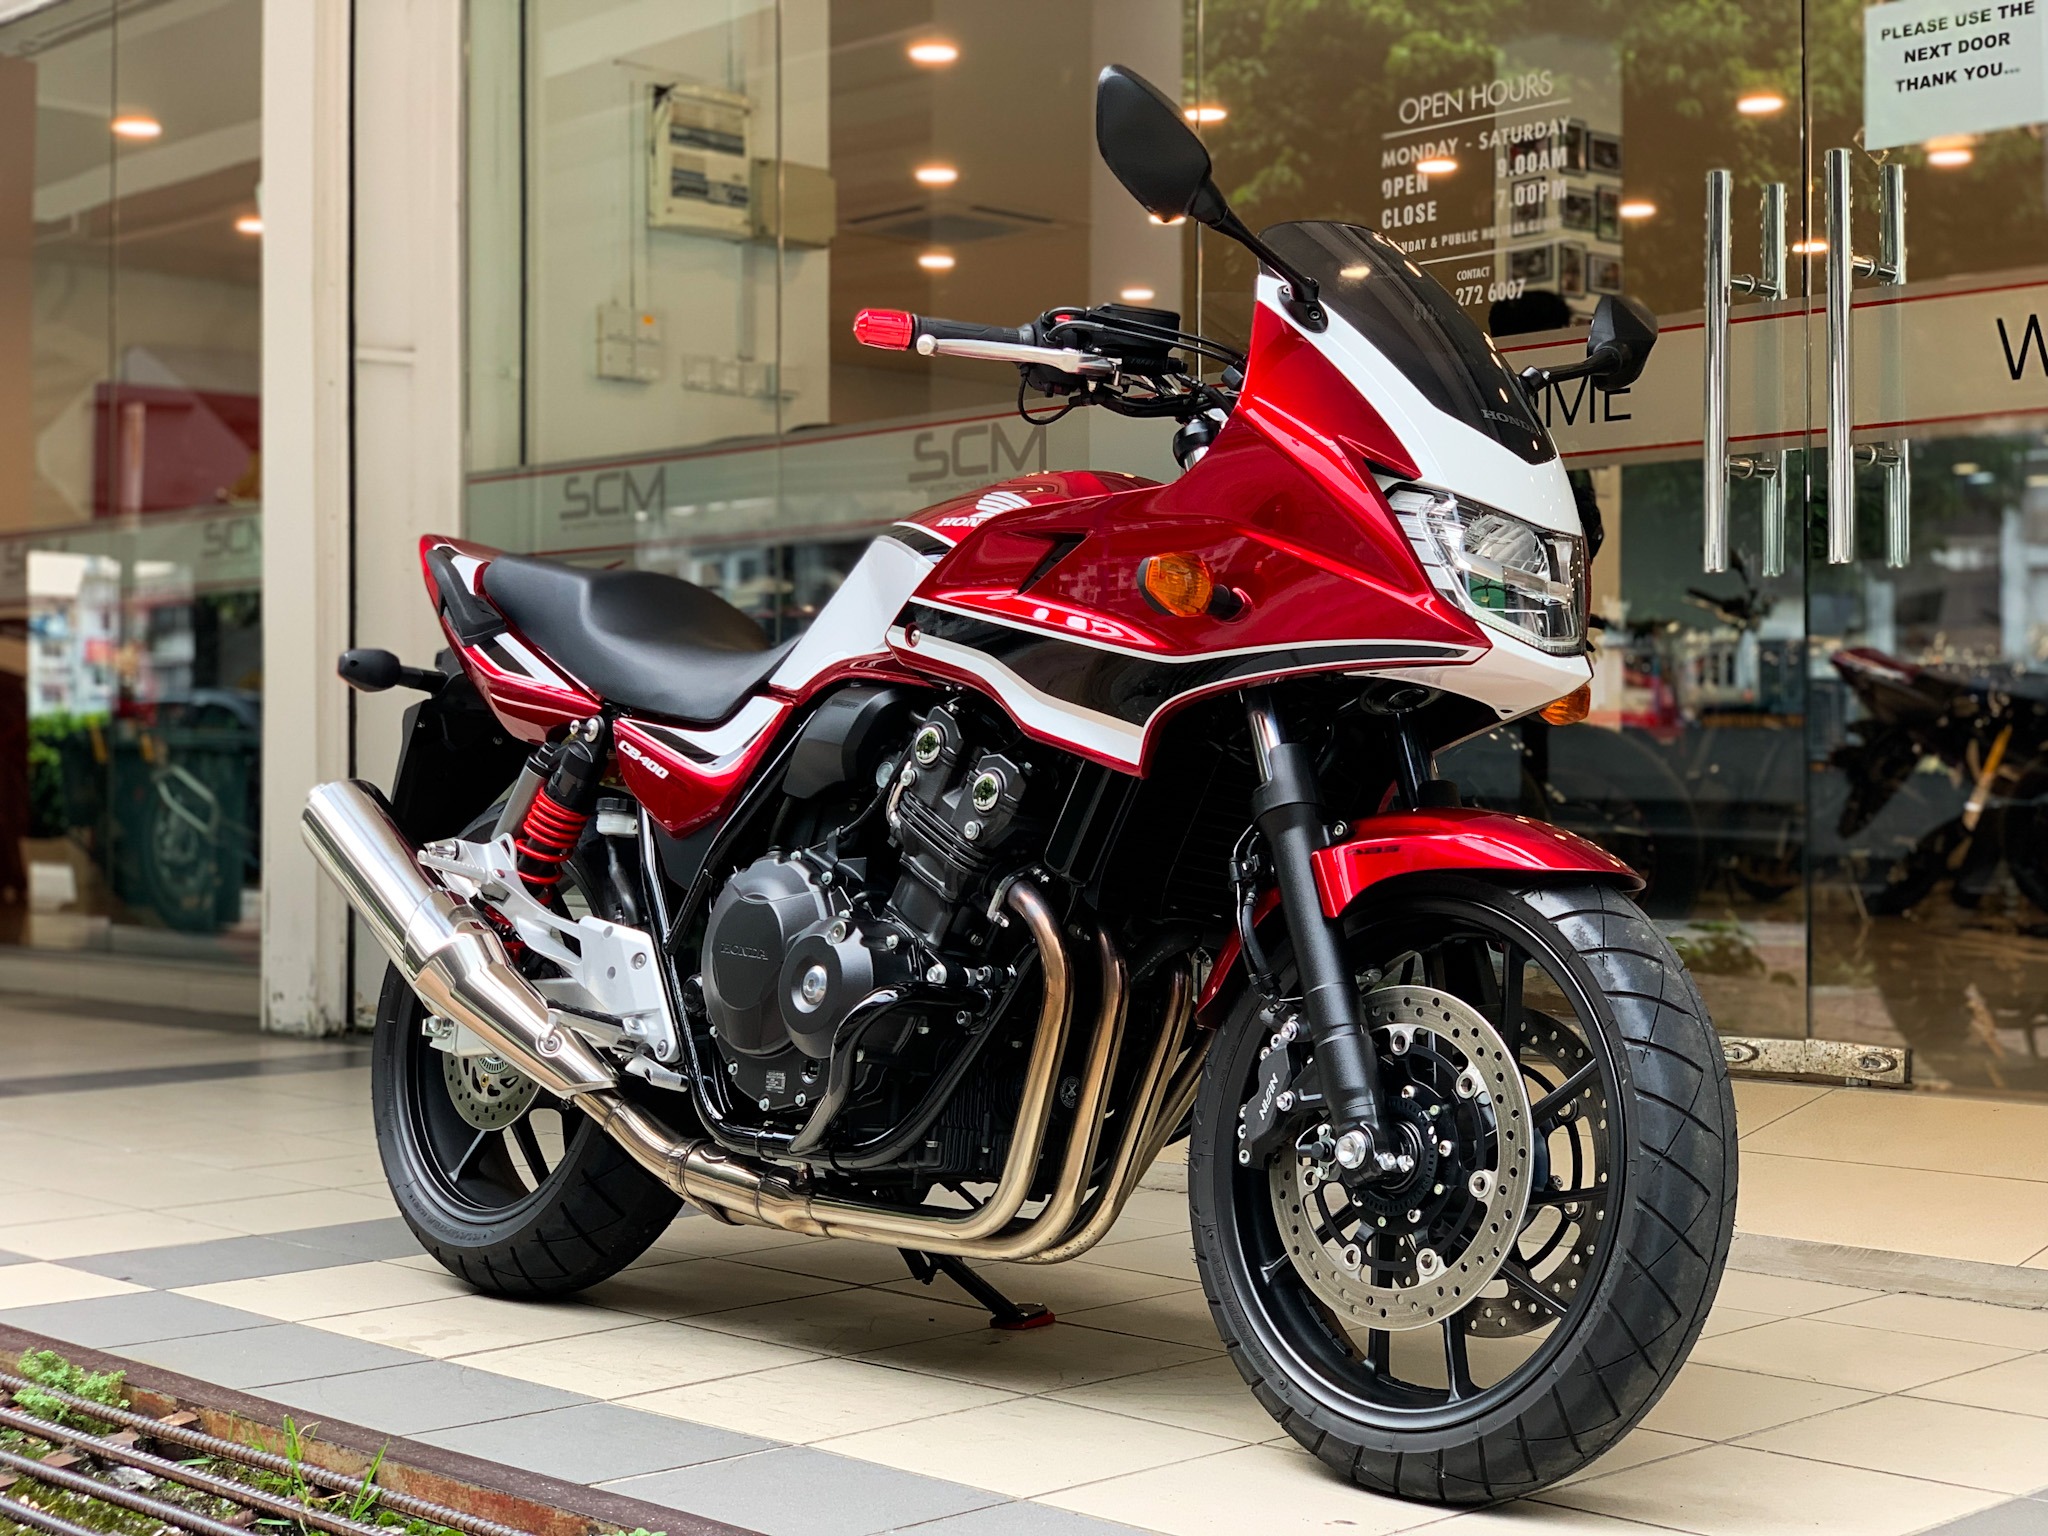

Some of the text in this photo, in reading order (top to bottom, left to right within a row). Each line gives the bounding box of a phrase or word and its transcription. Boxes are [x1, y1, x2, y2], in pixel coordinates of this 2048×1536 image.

[1881, 1, 2036, 41] PLEASE USE THE
[1904, 32, 2011, 64] NEXT DOOR
[1399, 70, 1553, 124] OPEN HOURS
[1896, 70, 1958, 93] THANK
[1381, 137, 1459, 169] MONDAY
[1479, 116, 1571, 150] SATURDAY
[1382, 146, 1568, 199] OPEN 9.00AM
[1381, 201, 1437, 229] CLOSE
[1398, 238, 1427, 254] NDAY
[1441, 230, 1479, 247] PUBLIC
[1456, 266, 1491, 281] CONTACT
[1488, 278, 1527, 303] 6007
[908, 414, 1048, 483] SCM
[559, 466, 667, 520] SCM
[618, 740, 669, 779] CB400
[720, 942, 769, 961] HONDA
[1258, 1072, 1279, 1121] NISSIN
